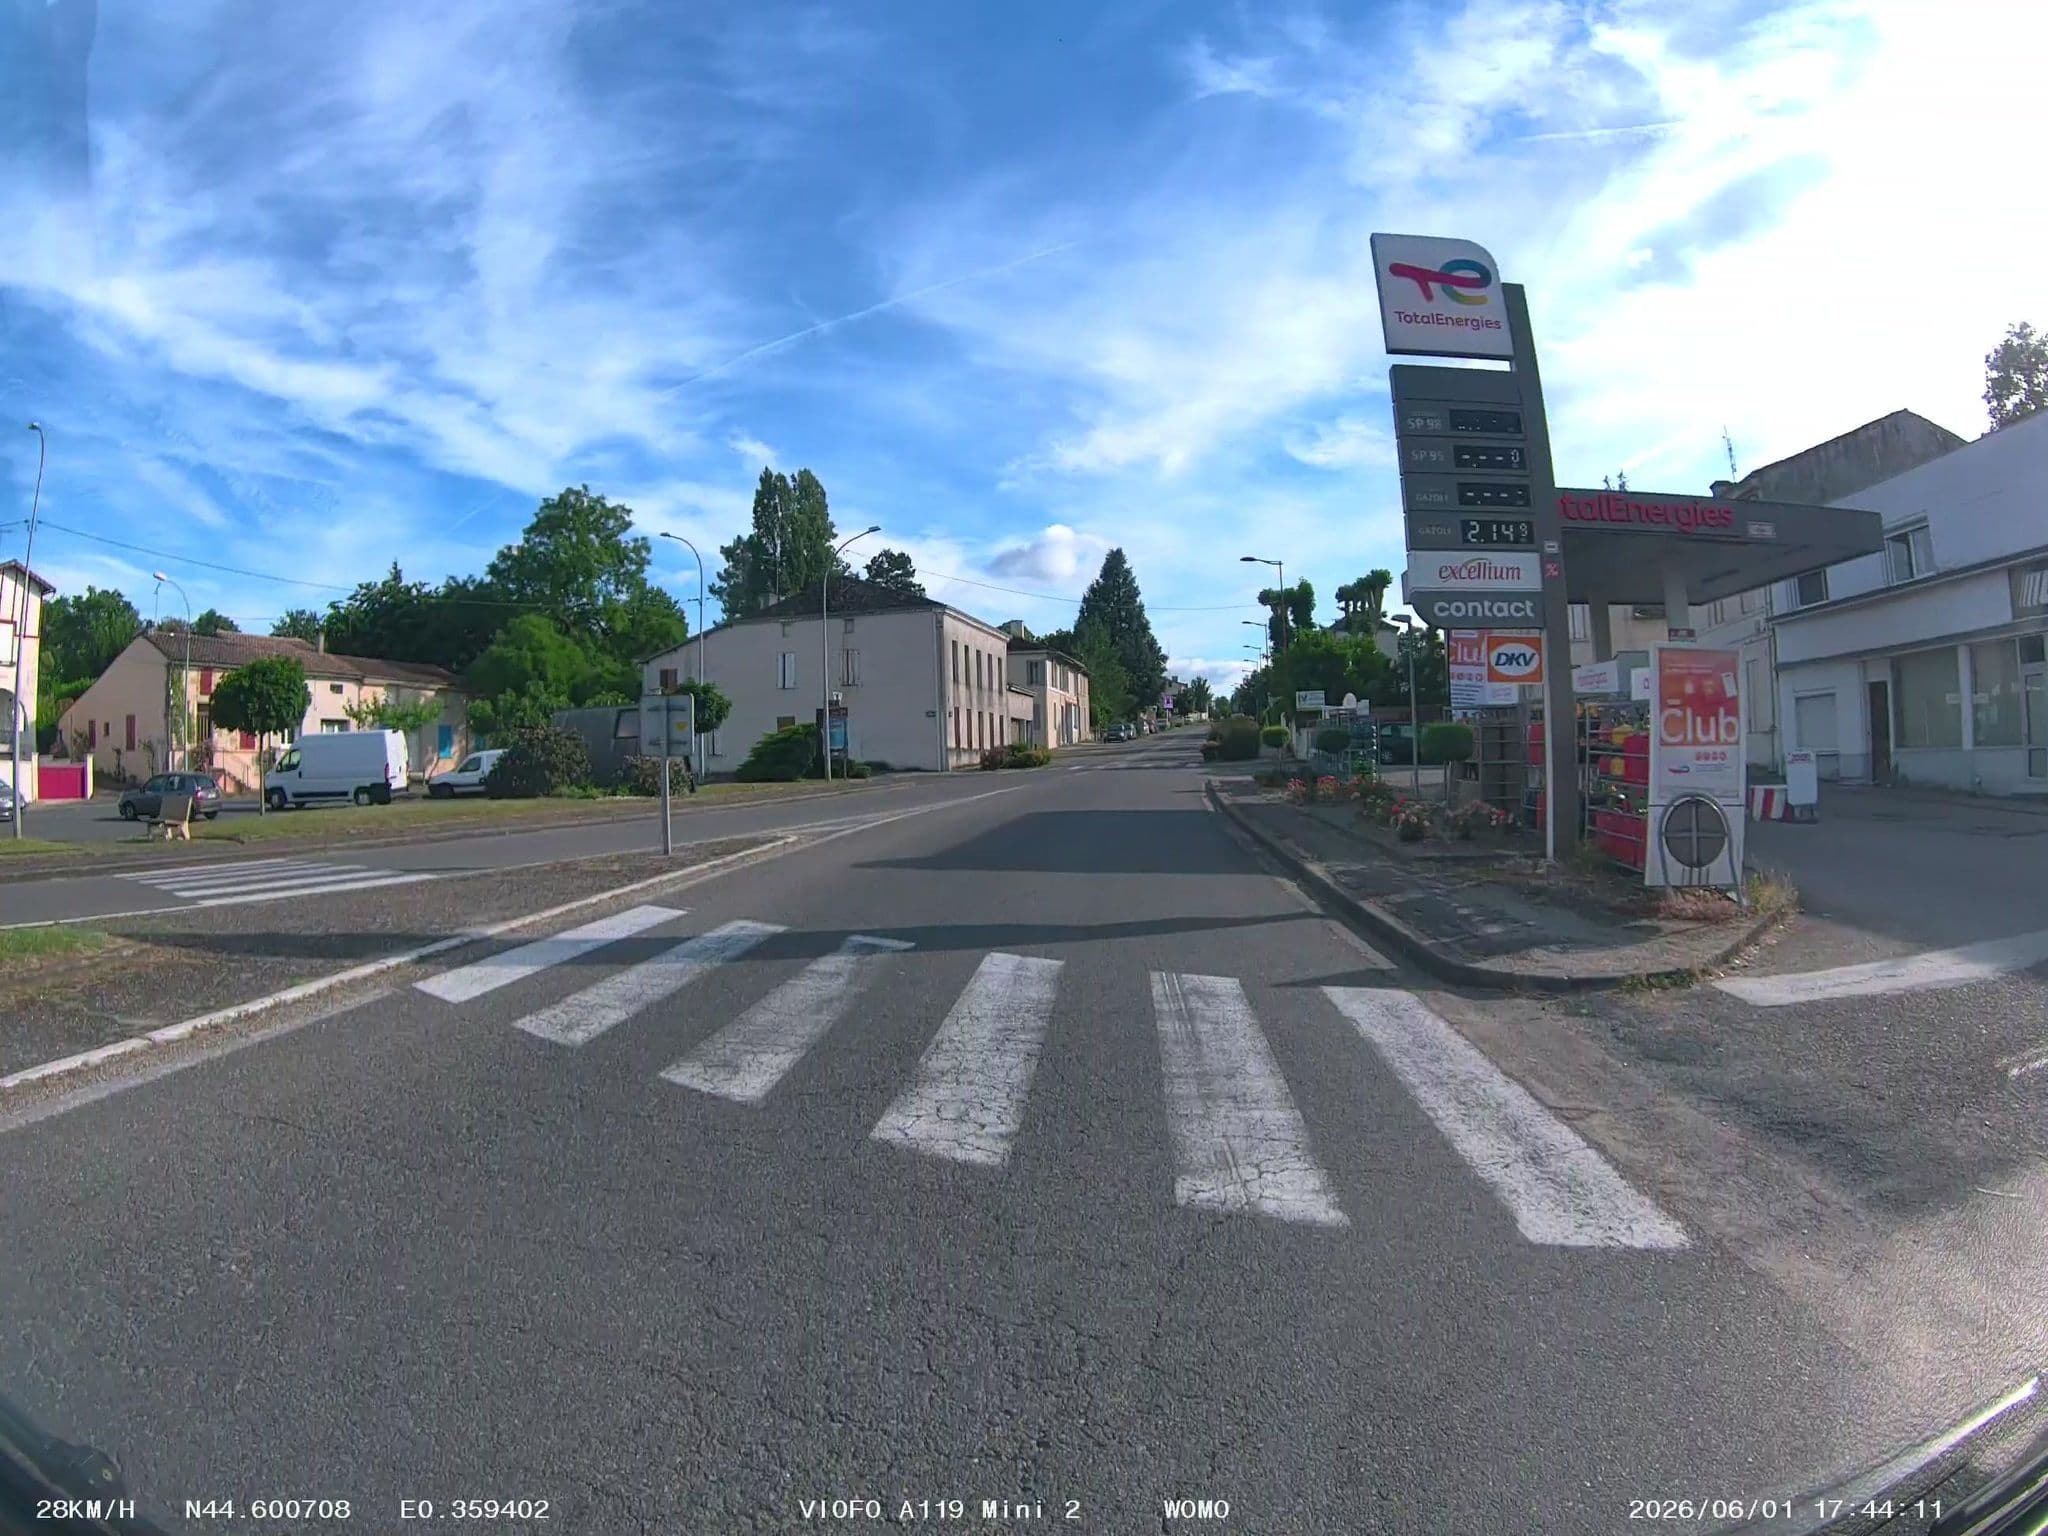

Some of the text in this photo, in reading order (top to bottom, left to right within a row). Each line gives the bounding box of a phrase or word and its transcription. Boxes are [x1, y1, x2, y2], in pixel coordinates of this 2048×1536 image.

[1393, 310, 1502, 331] TotalEnergies
[1407, 417, 1425, 430] SP
[1438, 560, 1521, 583] excellium
[1433, 600, 1535, 618] contact
[1494, 652, 1536, 667] DKV
[1660, 706, 1739, 743] Club
